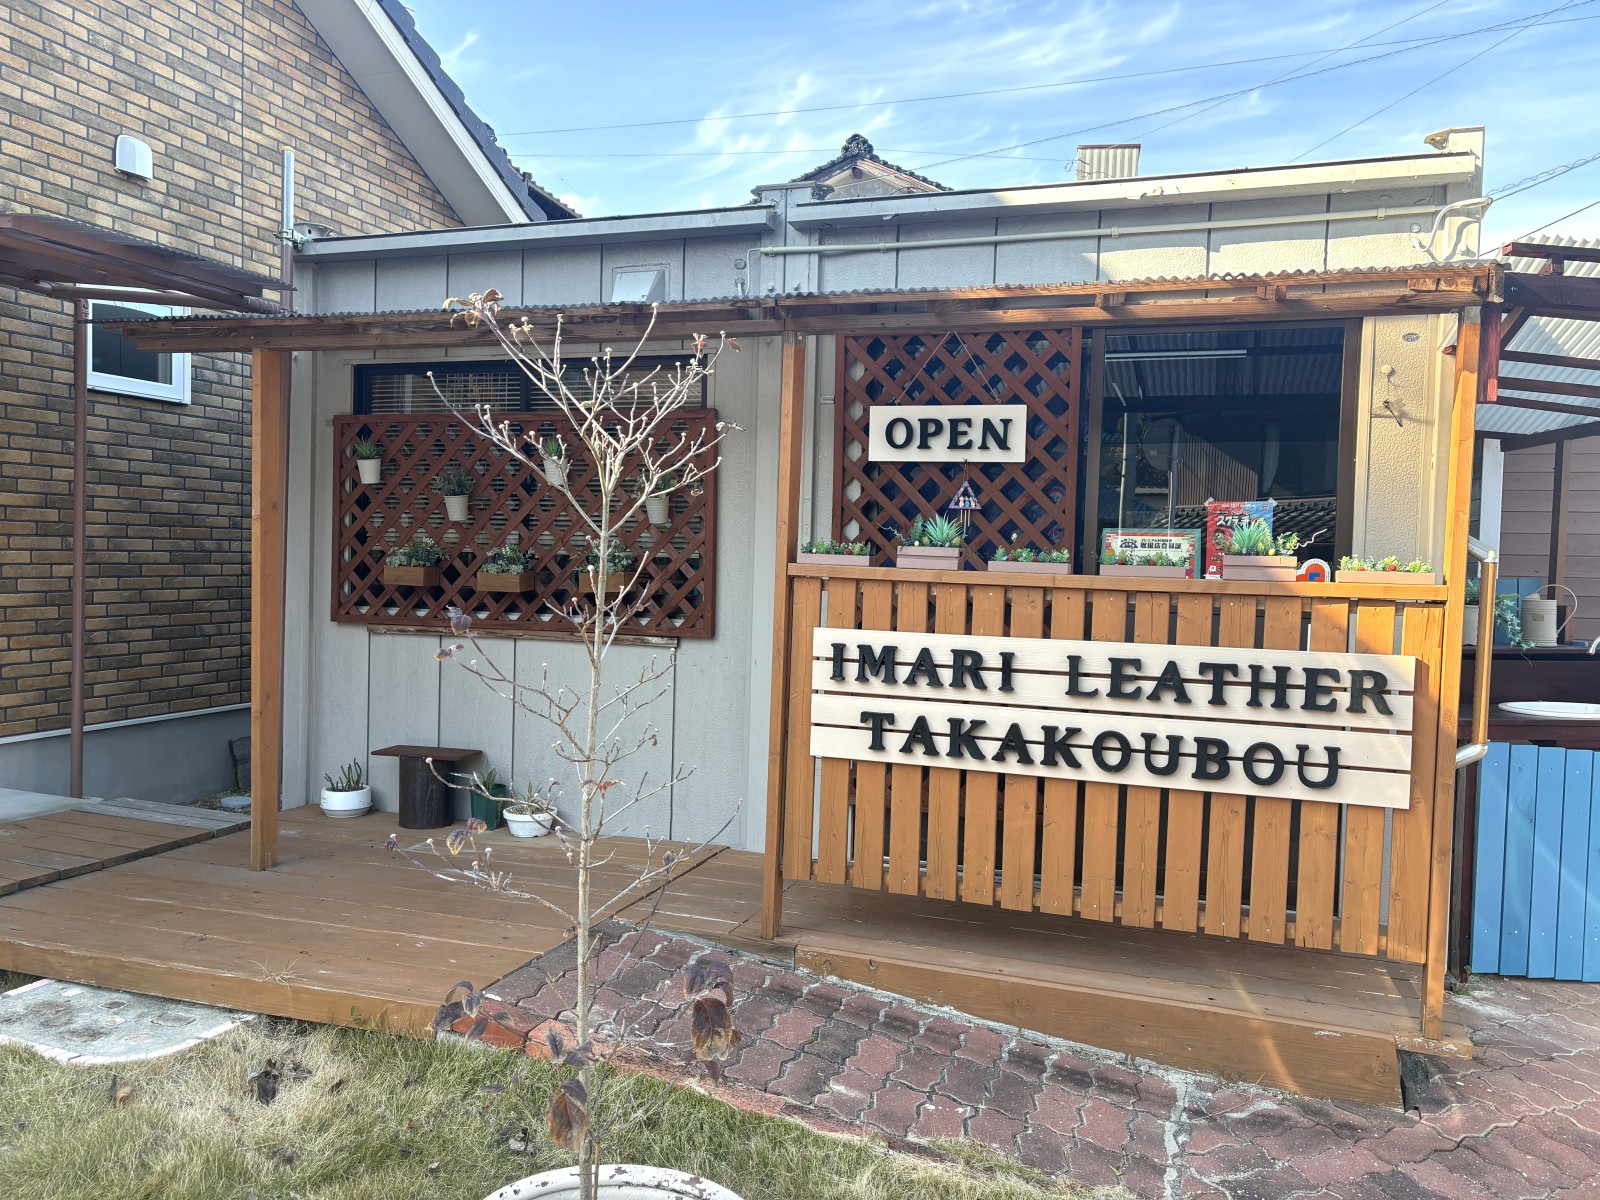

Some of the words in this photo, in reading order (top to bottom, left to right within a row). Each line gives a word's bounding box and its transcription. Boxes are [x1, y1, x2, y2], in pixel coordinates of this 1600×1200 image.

[885, 417, 1013, 451] OPEN
[830, 642, 1016, 692] IMARI
[1065, 654, 1394, 716] LEATHER
[859, 710, 1342, 790] TAKAKOUBOU
